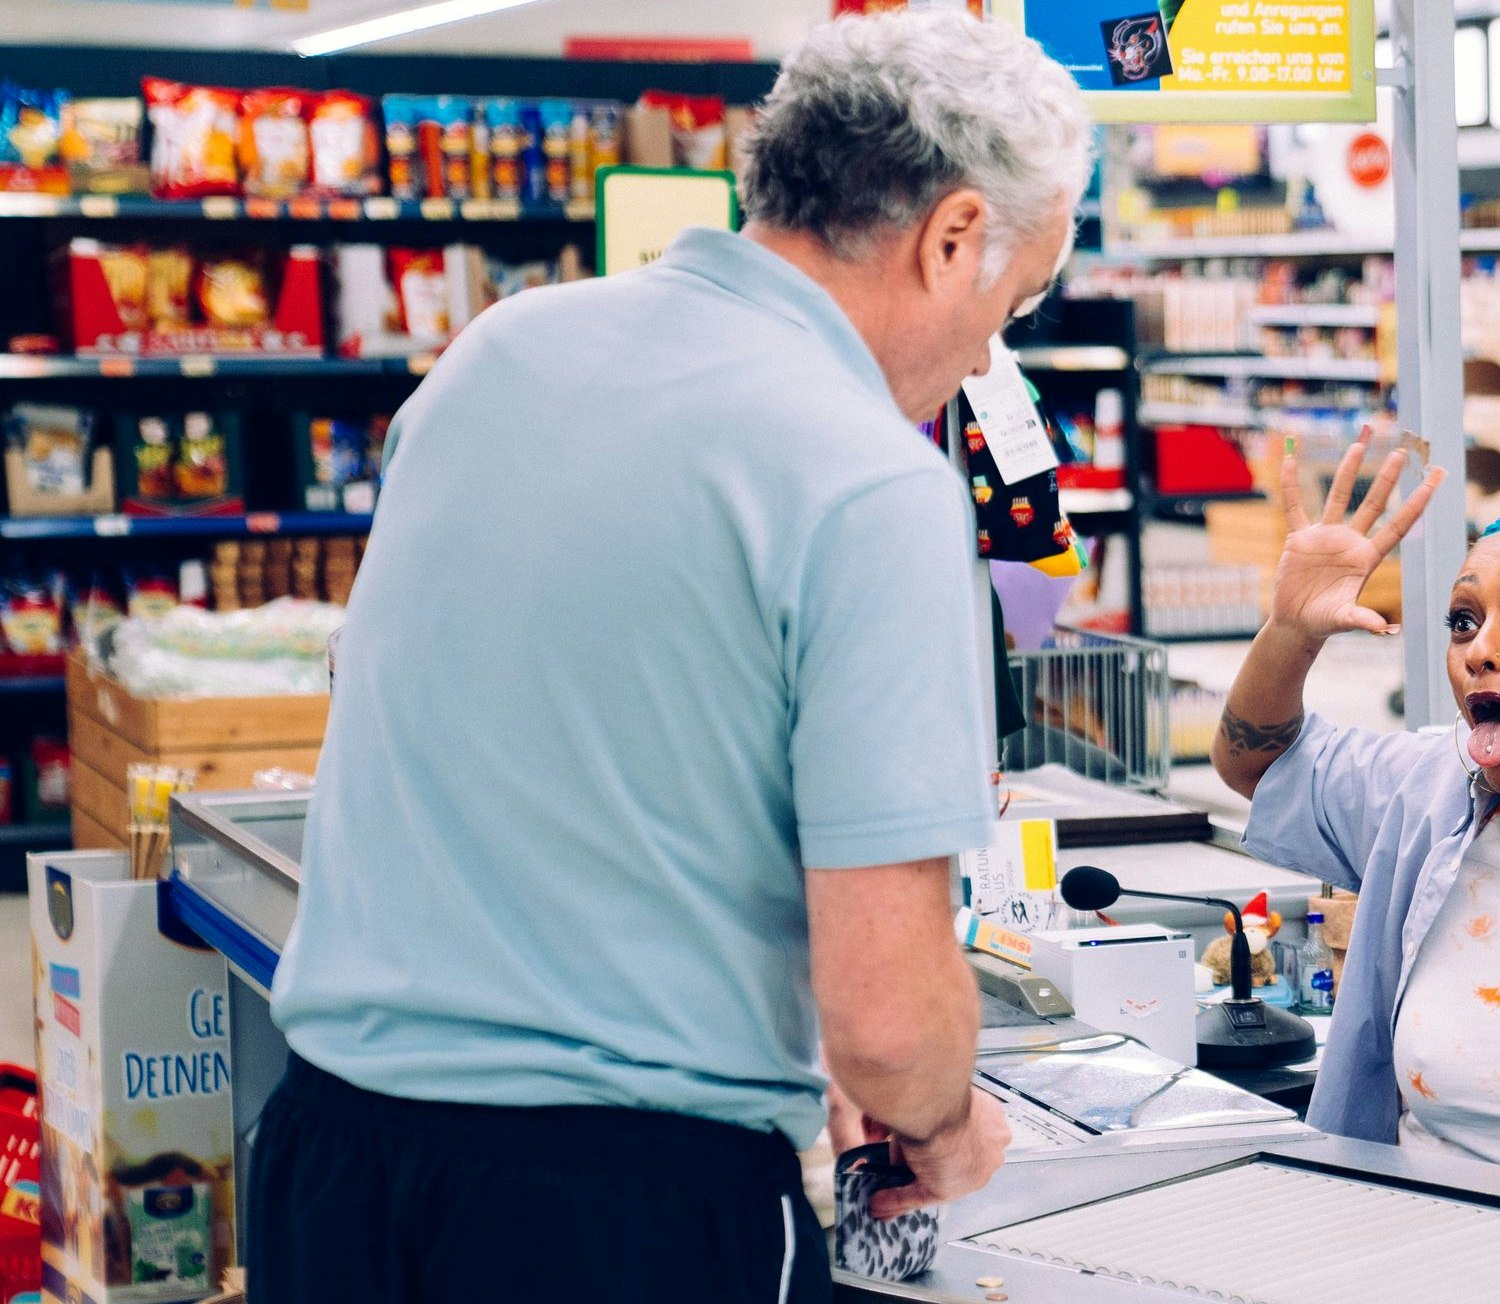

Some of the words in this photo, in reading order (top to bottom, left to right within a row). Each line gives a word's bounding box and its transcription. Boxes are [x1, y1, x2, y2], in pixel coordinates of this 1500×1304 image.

[1220, 2, 1249, 17] und
[1254, 2, 1343, 21] Anregungen
[1215, 19, 1256, 34] rufen
[1260, 19, 1284, 34] Sie
[1288, 22, 1316, 35] uns
[1181, 48, 1205, 64] Sie
[1210, 49, 1281, 64] erreichen
[1286, 52, 1313, 65] uns
[1318, 52, 1345, 65] von
[1317, 66, 1344, 82] Uhr
[190, 989, 225, 1038] GE
